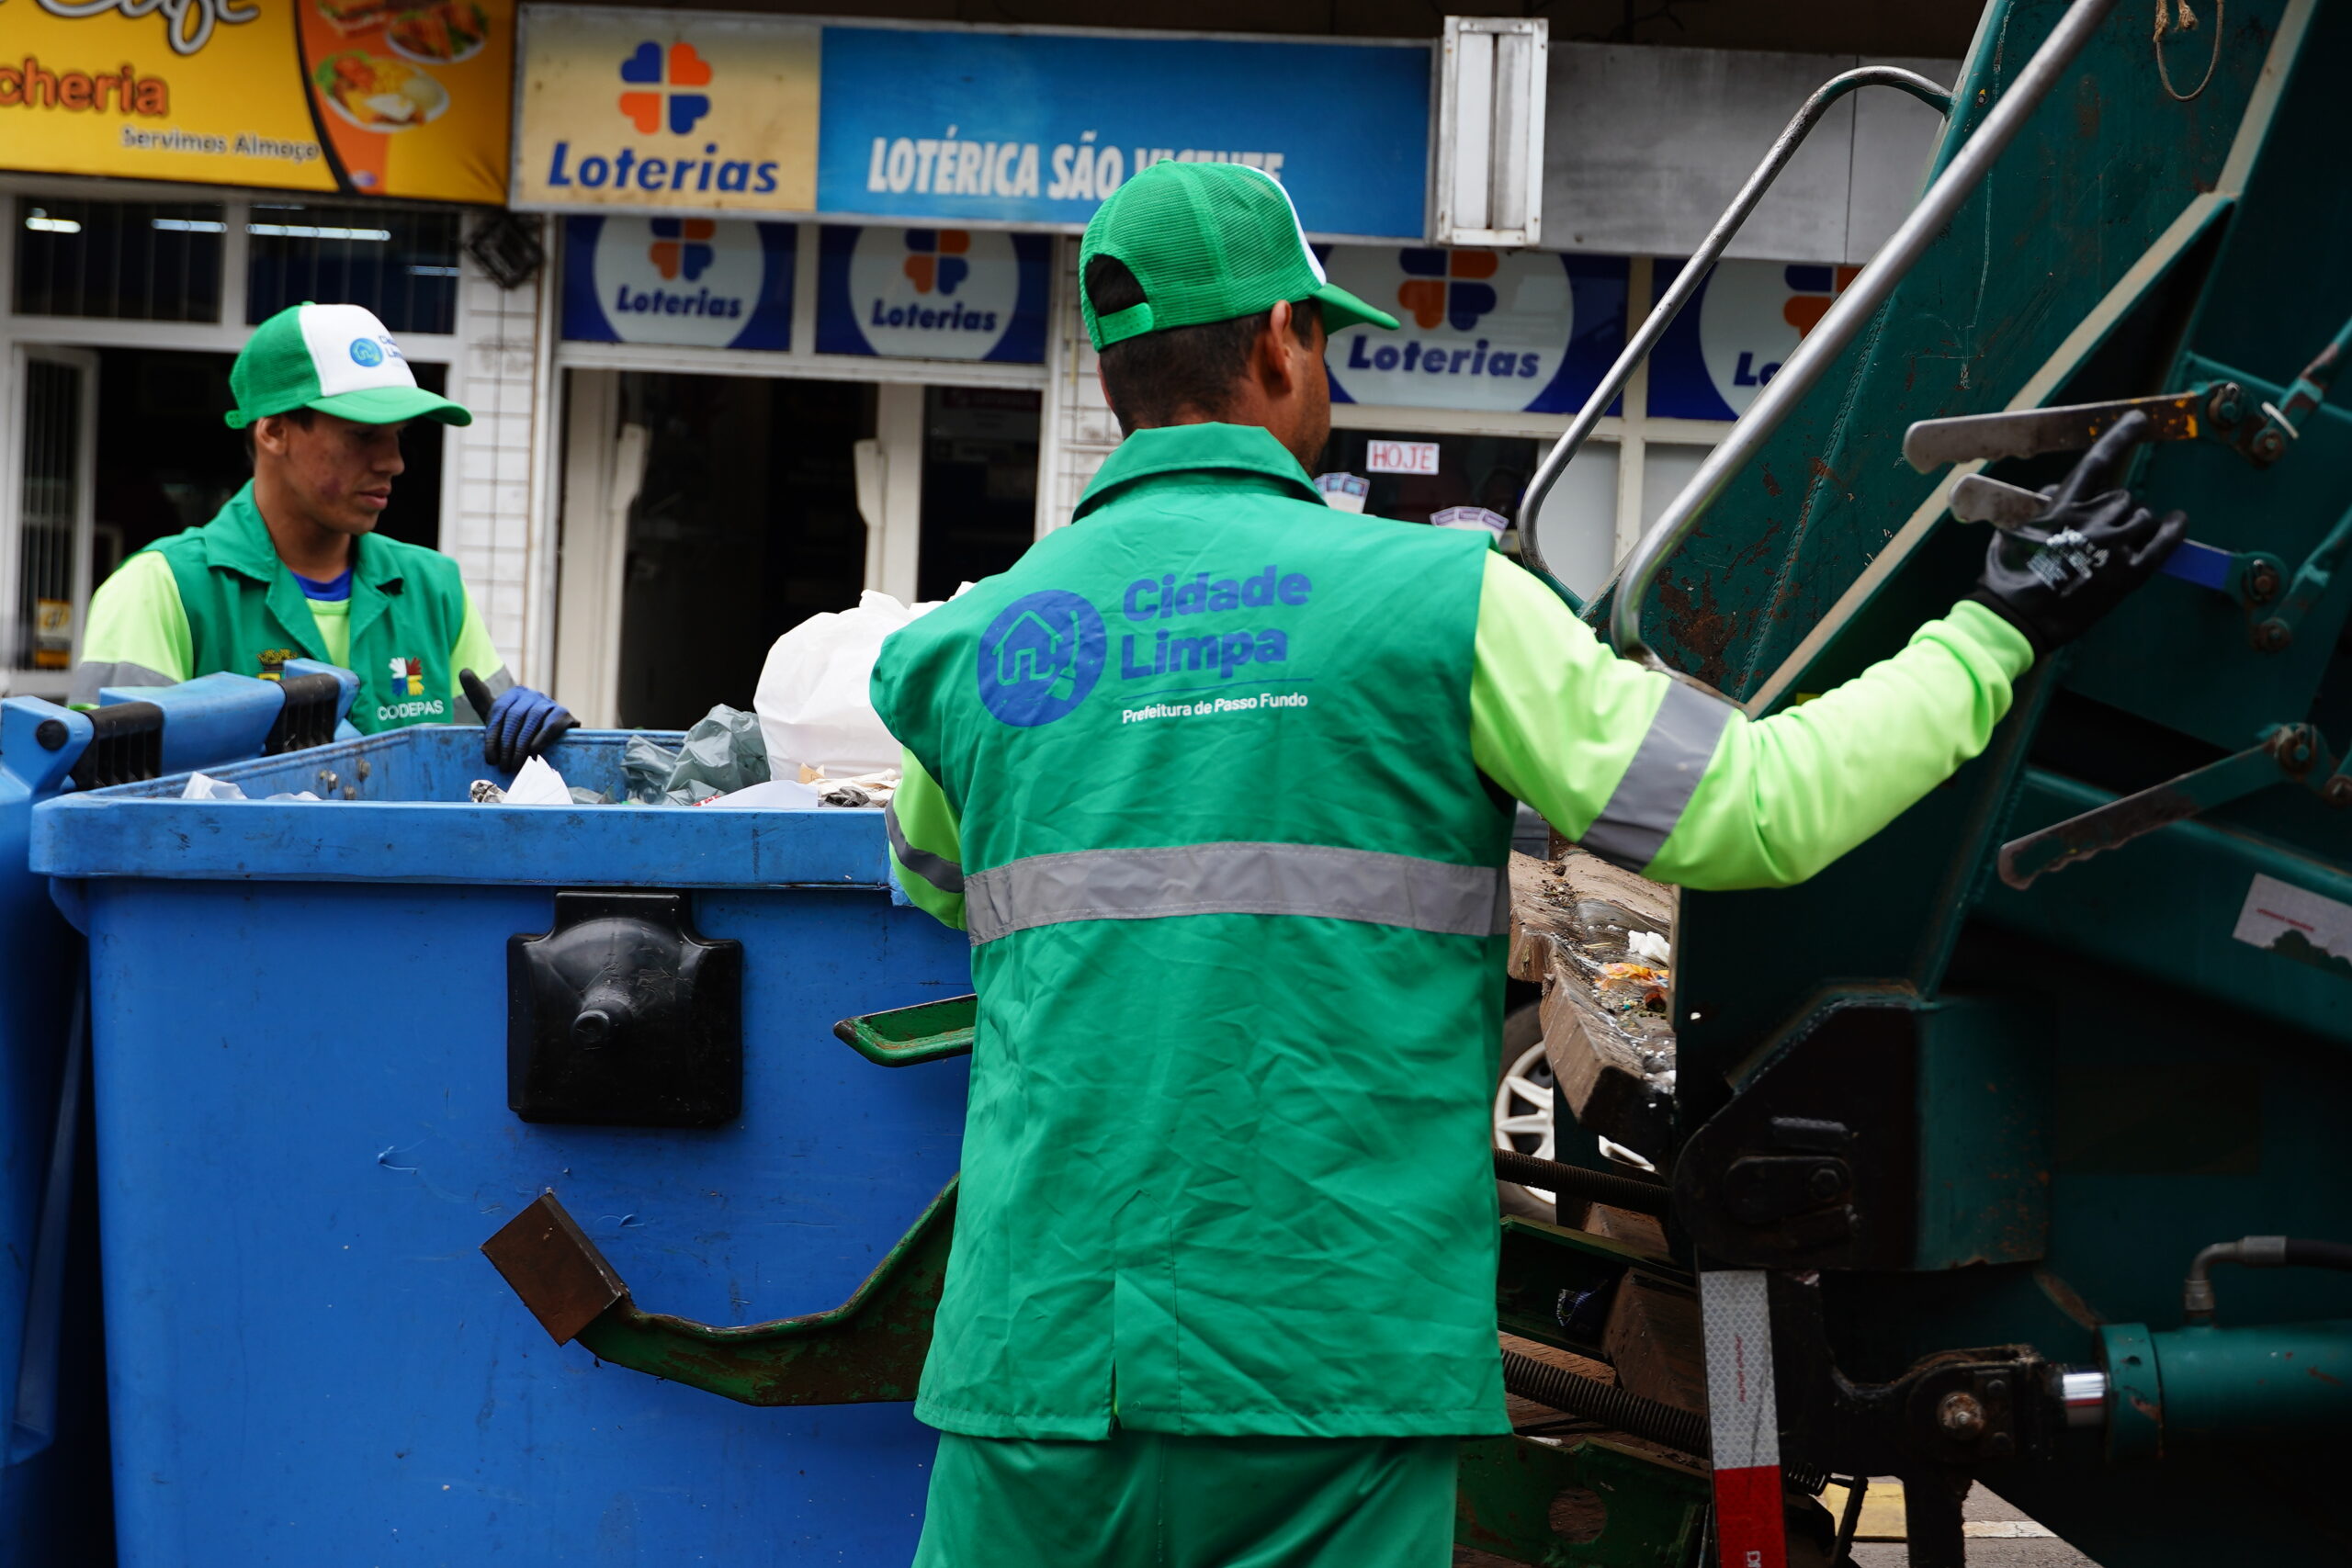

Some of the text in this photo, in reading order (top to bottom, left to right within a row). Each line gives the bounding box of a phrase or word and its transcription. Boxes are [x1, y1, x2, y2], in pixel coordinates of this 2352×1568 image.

[120, 125, 321, 164] Servimos Almoço
[867, 125, 1040, 197] LOTÉRICA
[1047, 130, 1124, 200] SÃO
[548, 141, 780, 194] Loterias
[616, 285, 742, 320] Loterias
[871, 299, 997, 333] Loterias
[1348, 335, 1541, 379] Loterias
[1372, 445, 1434, 471] HOJE
[1122, 564, 1313, 622] Cidade
[1120, 628, 1289, 681] Limpa
[377, 699, 444, 721] CODEPAS
[1121, 692, 1308, 724] Prefeitura de Passo Fundo
